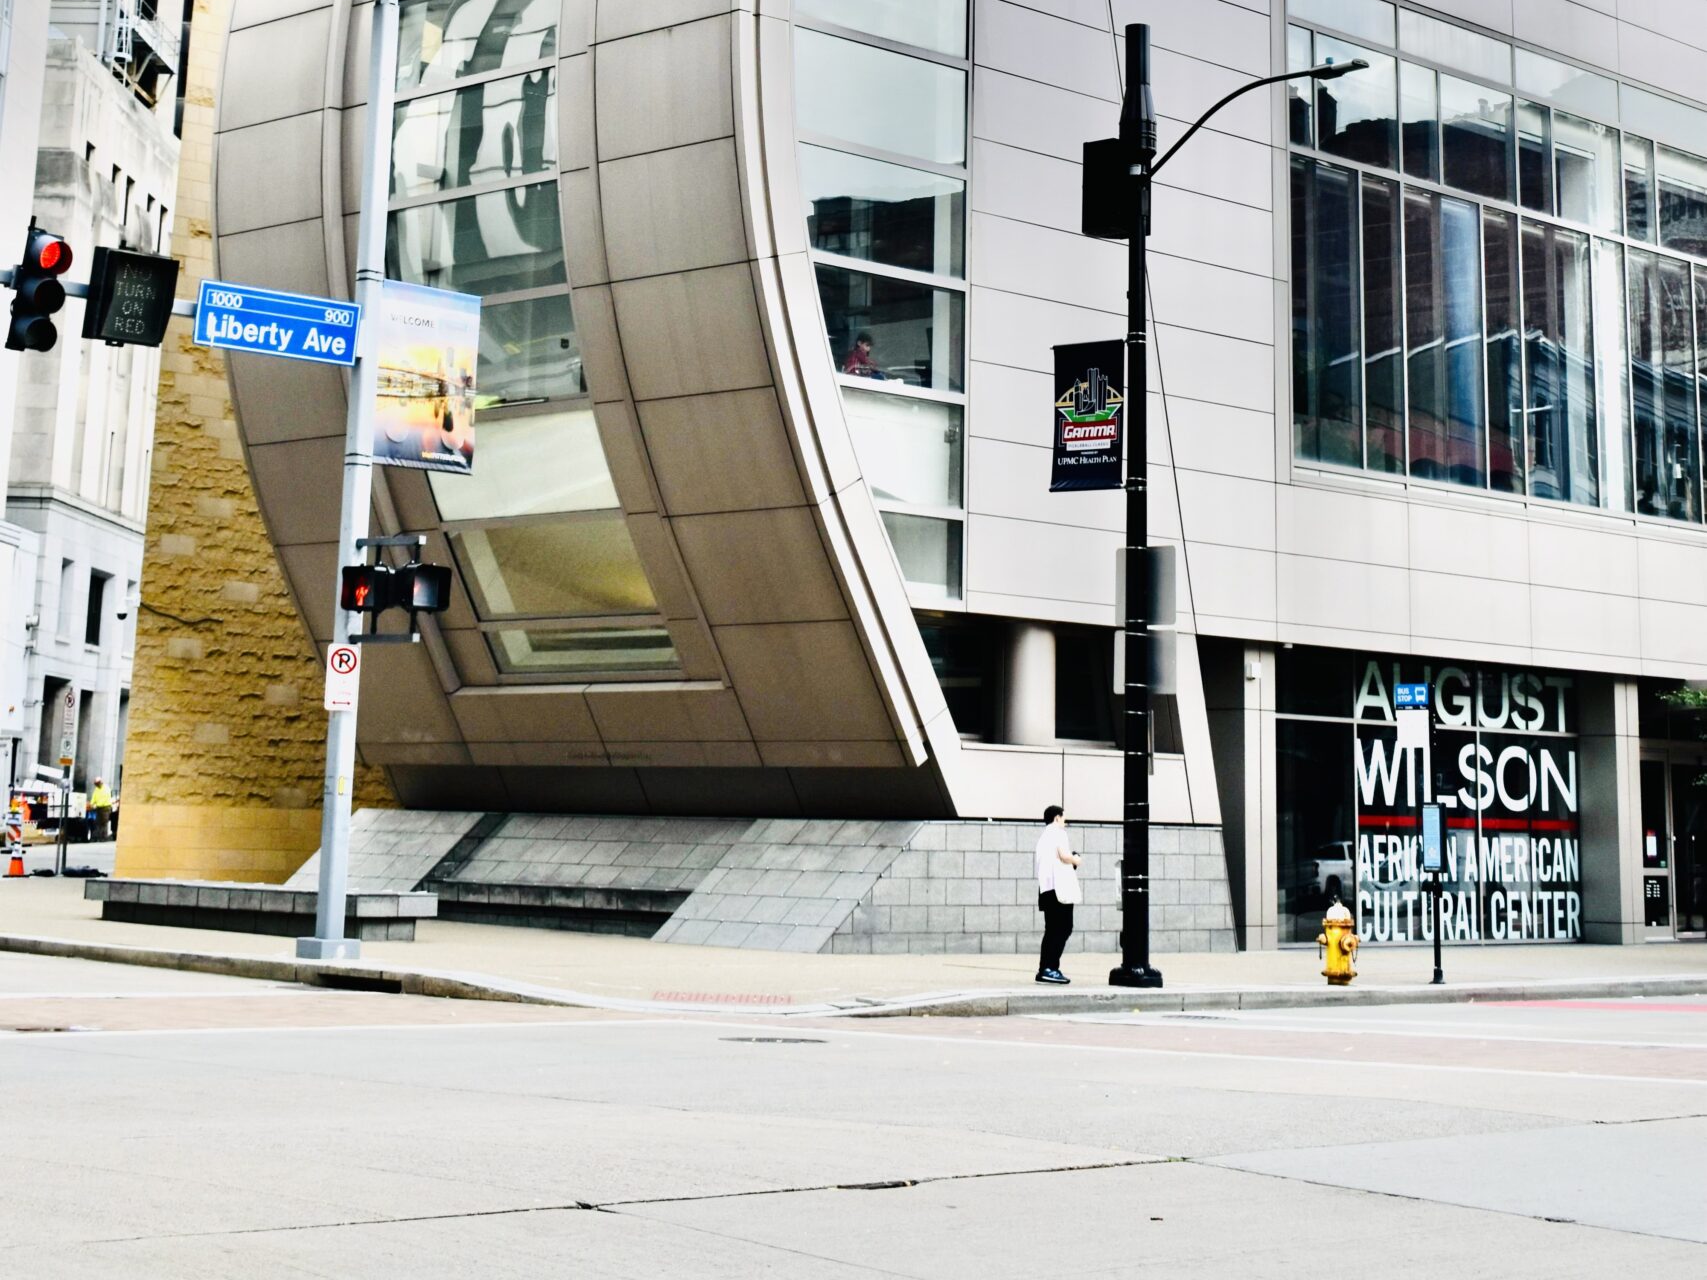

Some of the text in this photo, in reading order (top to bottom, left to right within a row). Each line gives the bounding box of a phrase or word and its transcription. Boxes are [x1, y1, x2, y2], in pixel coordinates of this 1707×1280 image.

[116, 281, 156, 300] TURN
[122, 300, 144, 316] ON
[211, 292, 244, 308] 1000
[114, 316, 145, 334] RED
[324, 310, 350, 325] 900
[206, 312, 346, 356] Liberty Ave
[1064, 425, 1115, 439] GAMMA
[1057, 455, 1117, 466] UPMC HEALTH PLAN
[1355, 738, 1578, 812] WILSON
[1358, 834, 1457, 882] AFRICN
[1464, 836, 1580, 882] AMERICAN
[1358, 891, 1581, 941] CULTURAL CENTER
